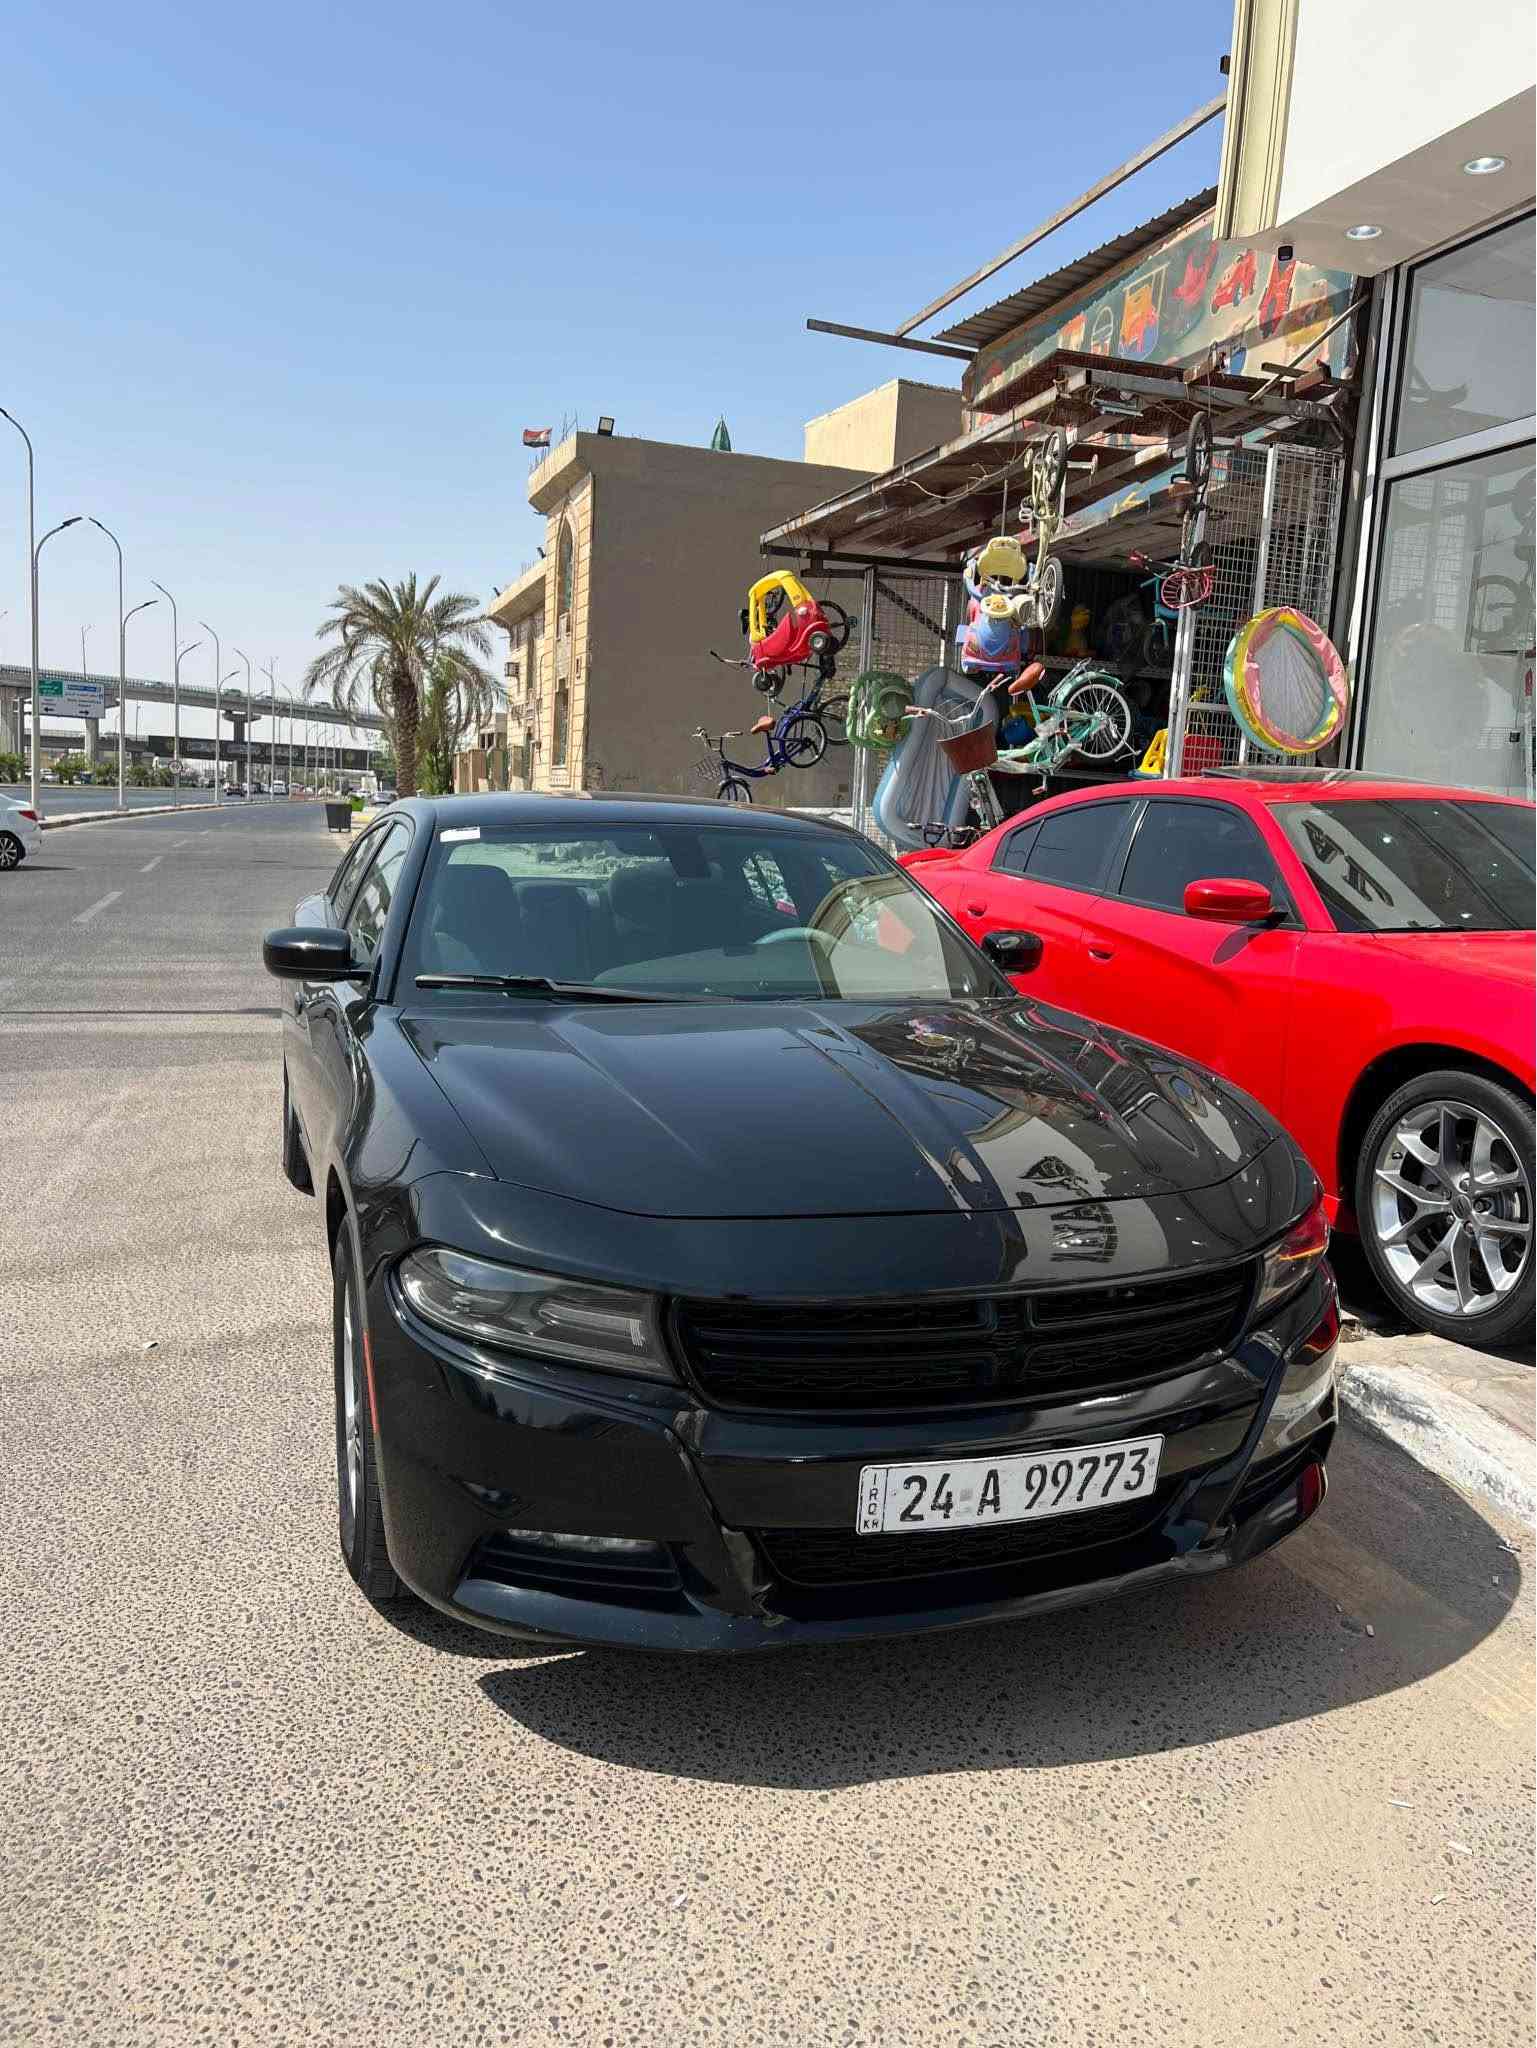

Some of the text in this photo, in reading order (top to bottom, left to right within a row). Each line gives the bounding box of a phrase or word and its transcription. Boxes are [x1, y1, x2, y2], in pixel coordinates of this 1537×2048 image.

[899, 1447, 1150, 1522] 24 A 99773
